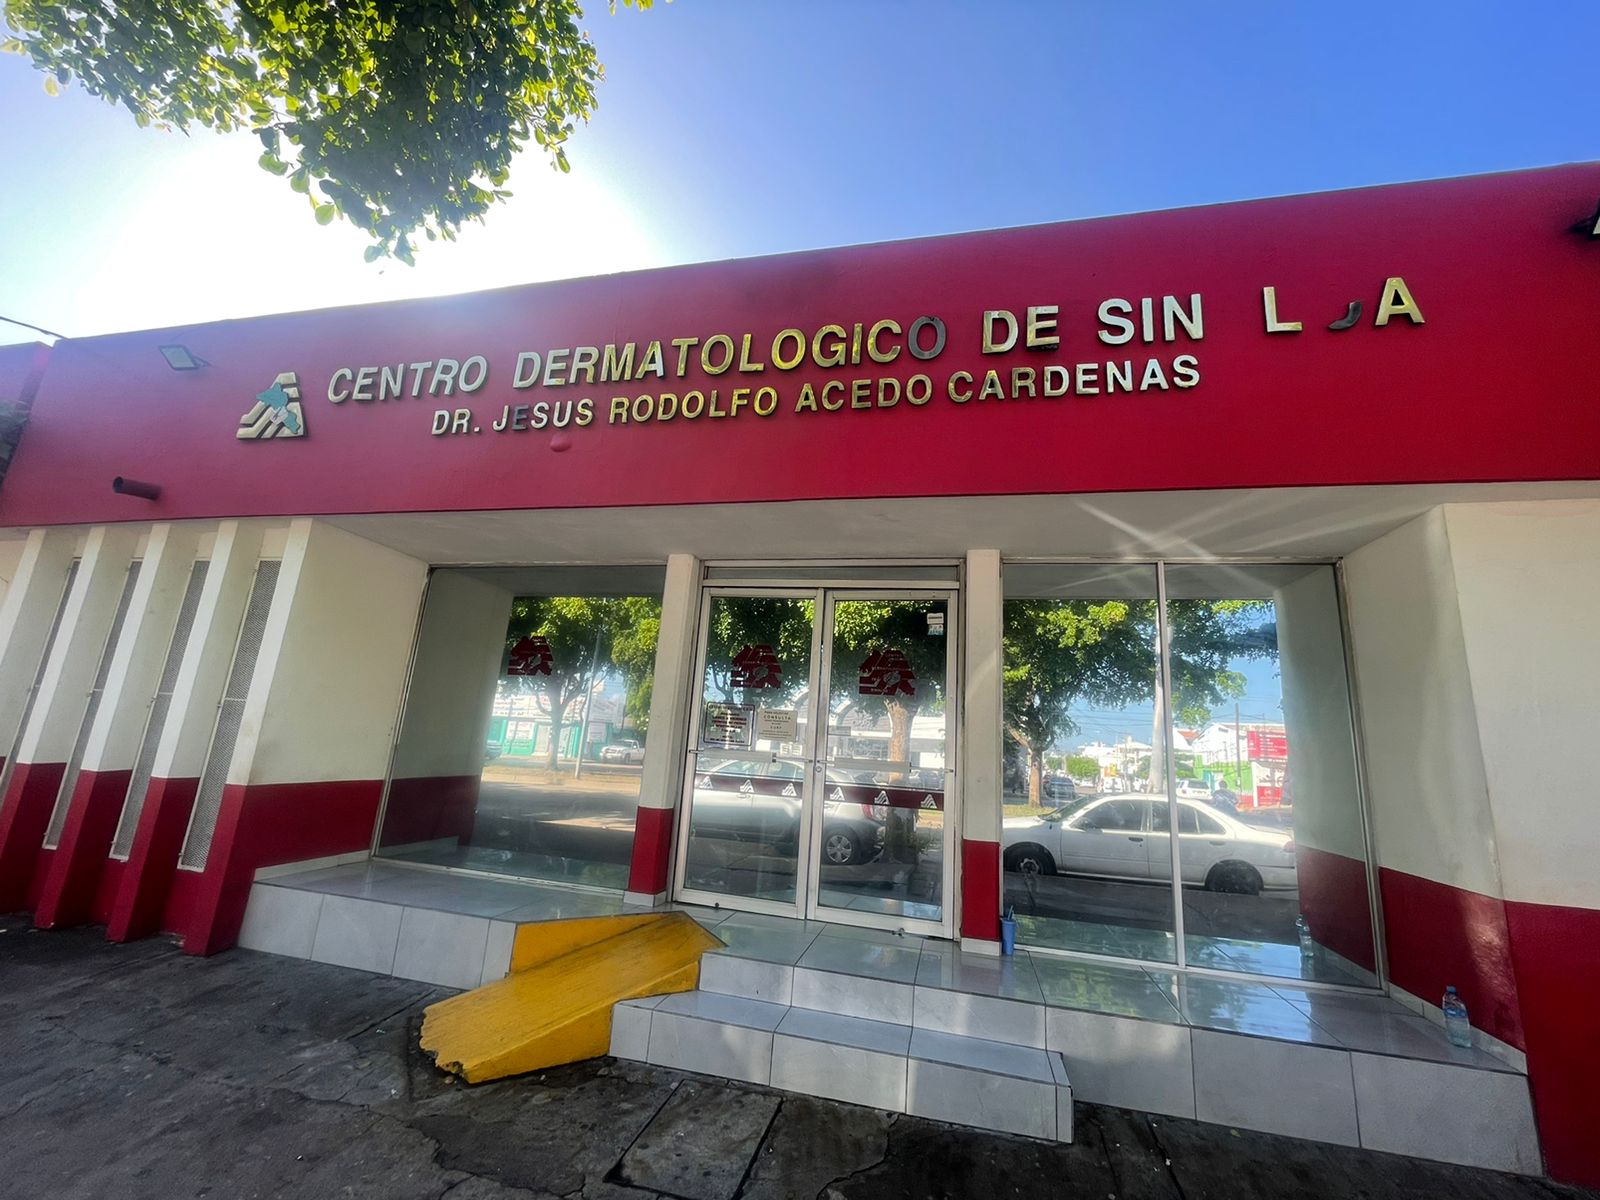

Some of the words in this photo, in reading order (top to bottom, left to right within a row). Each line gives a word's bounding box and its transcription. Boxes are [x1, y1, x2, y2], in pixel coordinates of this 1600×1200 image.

[327, 355, 488, 403] CENTRO
[512, 315, 947, 388] DERMATOLOGICO
[982, 305, 1060, 354] DE
[432, 409, 480, 436] DR.
[493, 398, 594, 432] JESUS
[608, 386, 778, 424] RODOLFO
[795, 373, 933, 413] ACEDO
[947, 355, 1200, 402] CARDENAS
